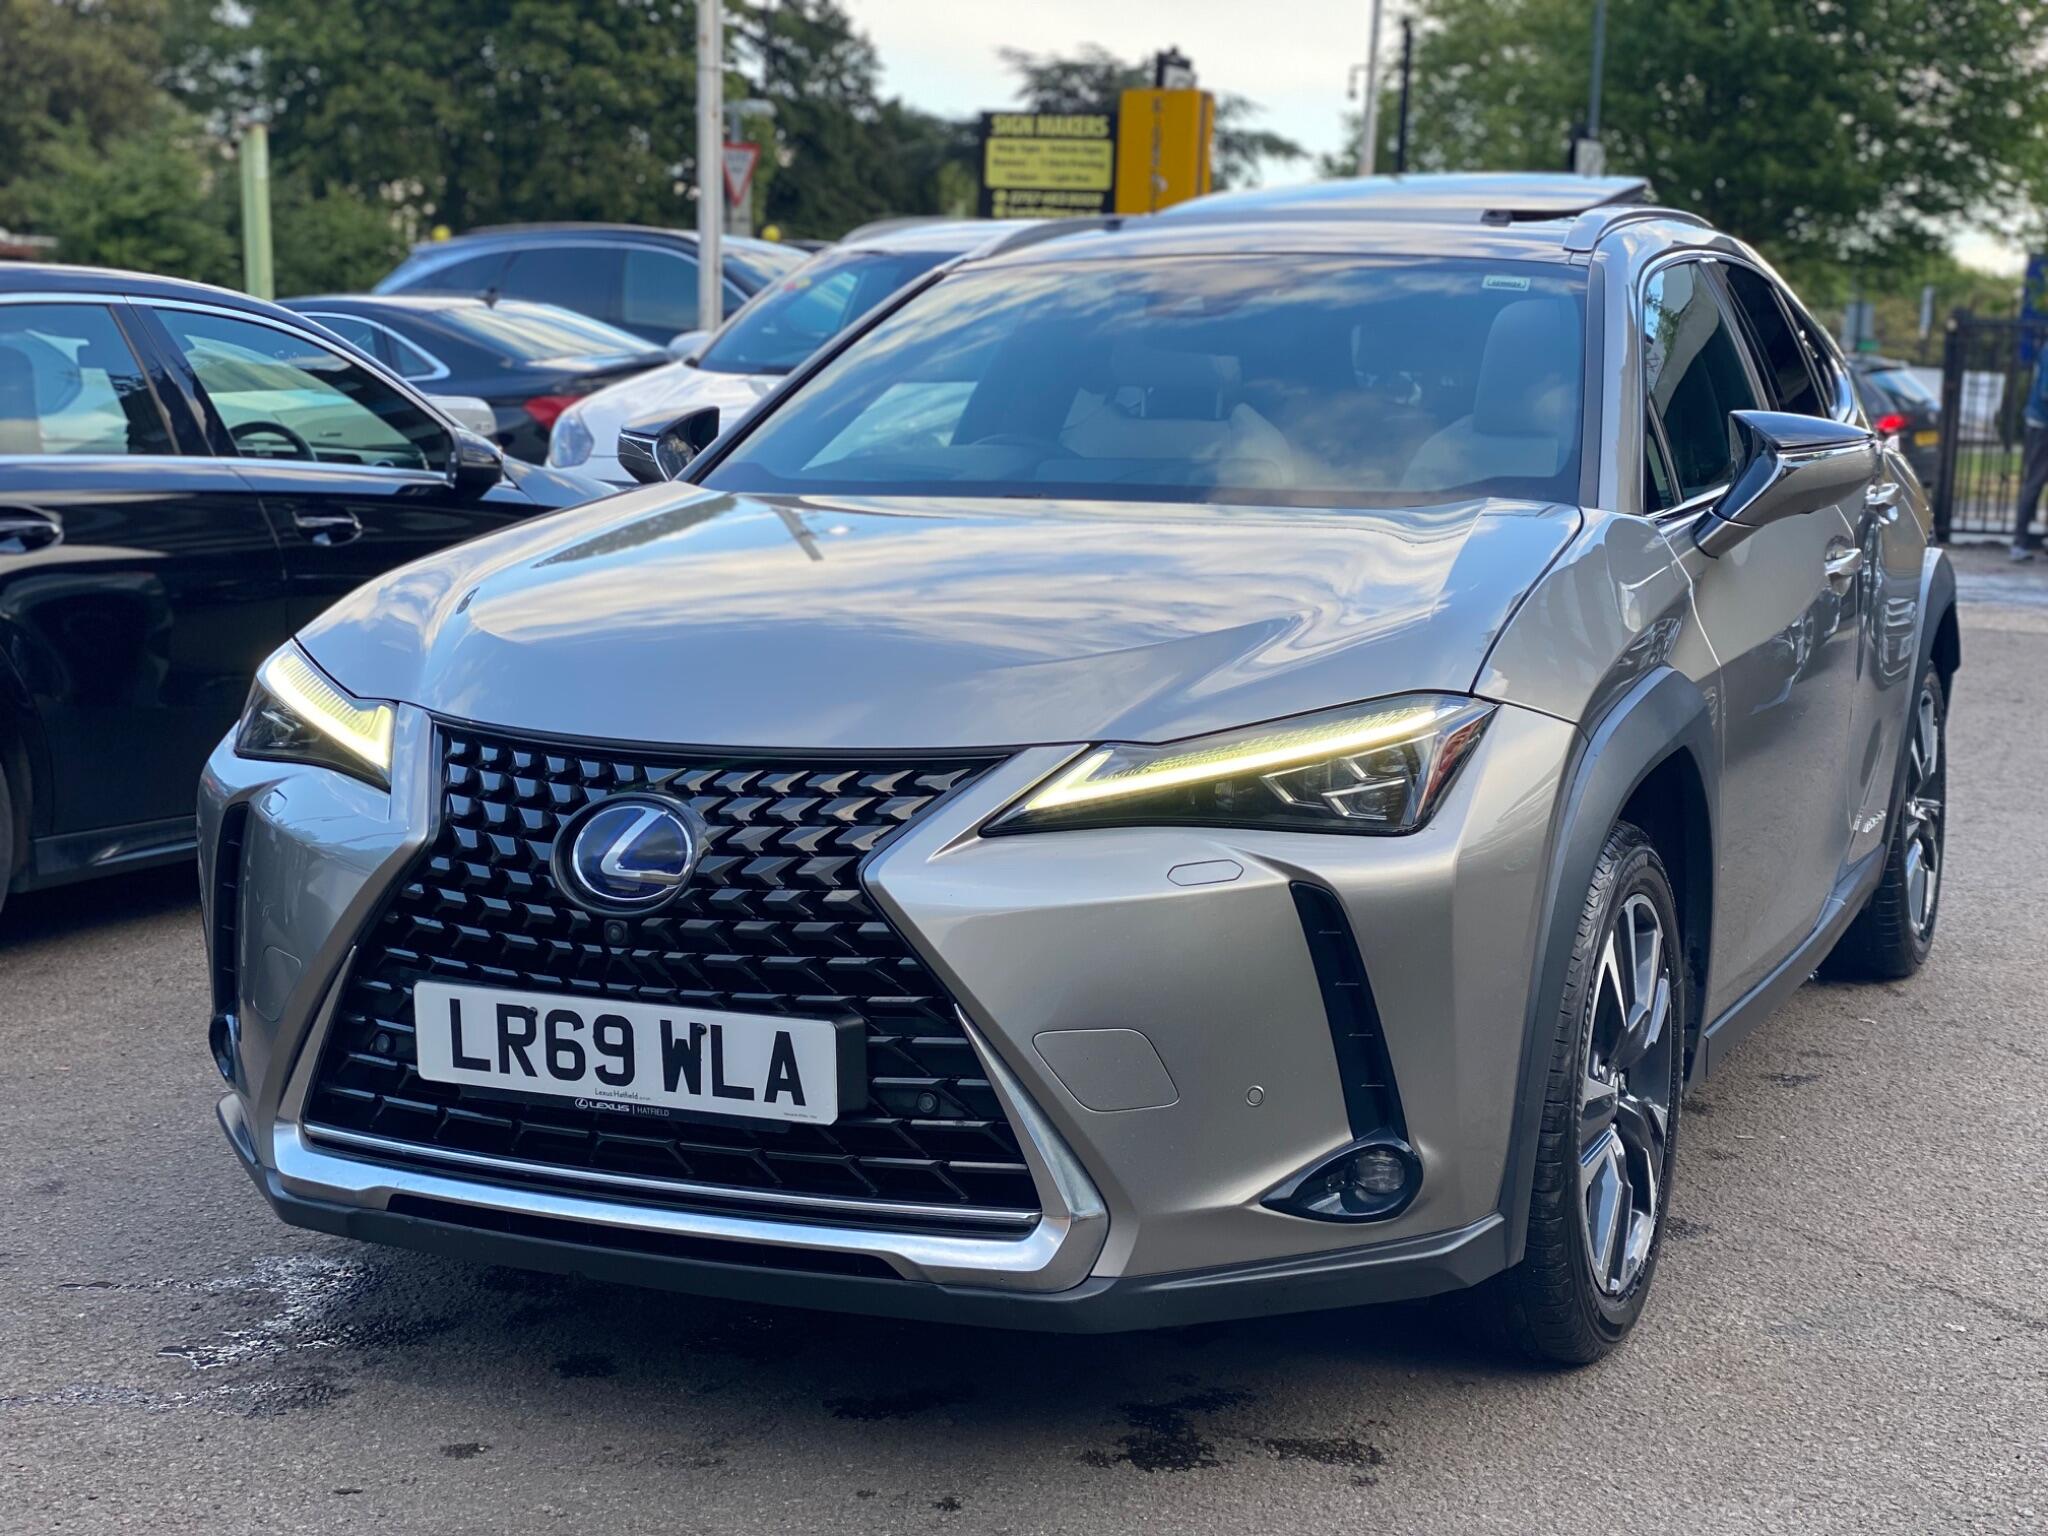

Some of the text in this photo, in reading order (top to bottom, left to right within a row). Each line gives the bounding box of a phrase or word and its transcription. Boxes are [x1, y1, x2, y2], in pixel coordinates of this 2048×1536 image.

[448, 998, 807, 1107] LR69 WLA
[589, 1100, 670, 1117] LEXUS HATFIELD
